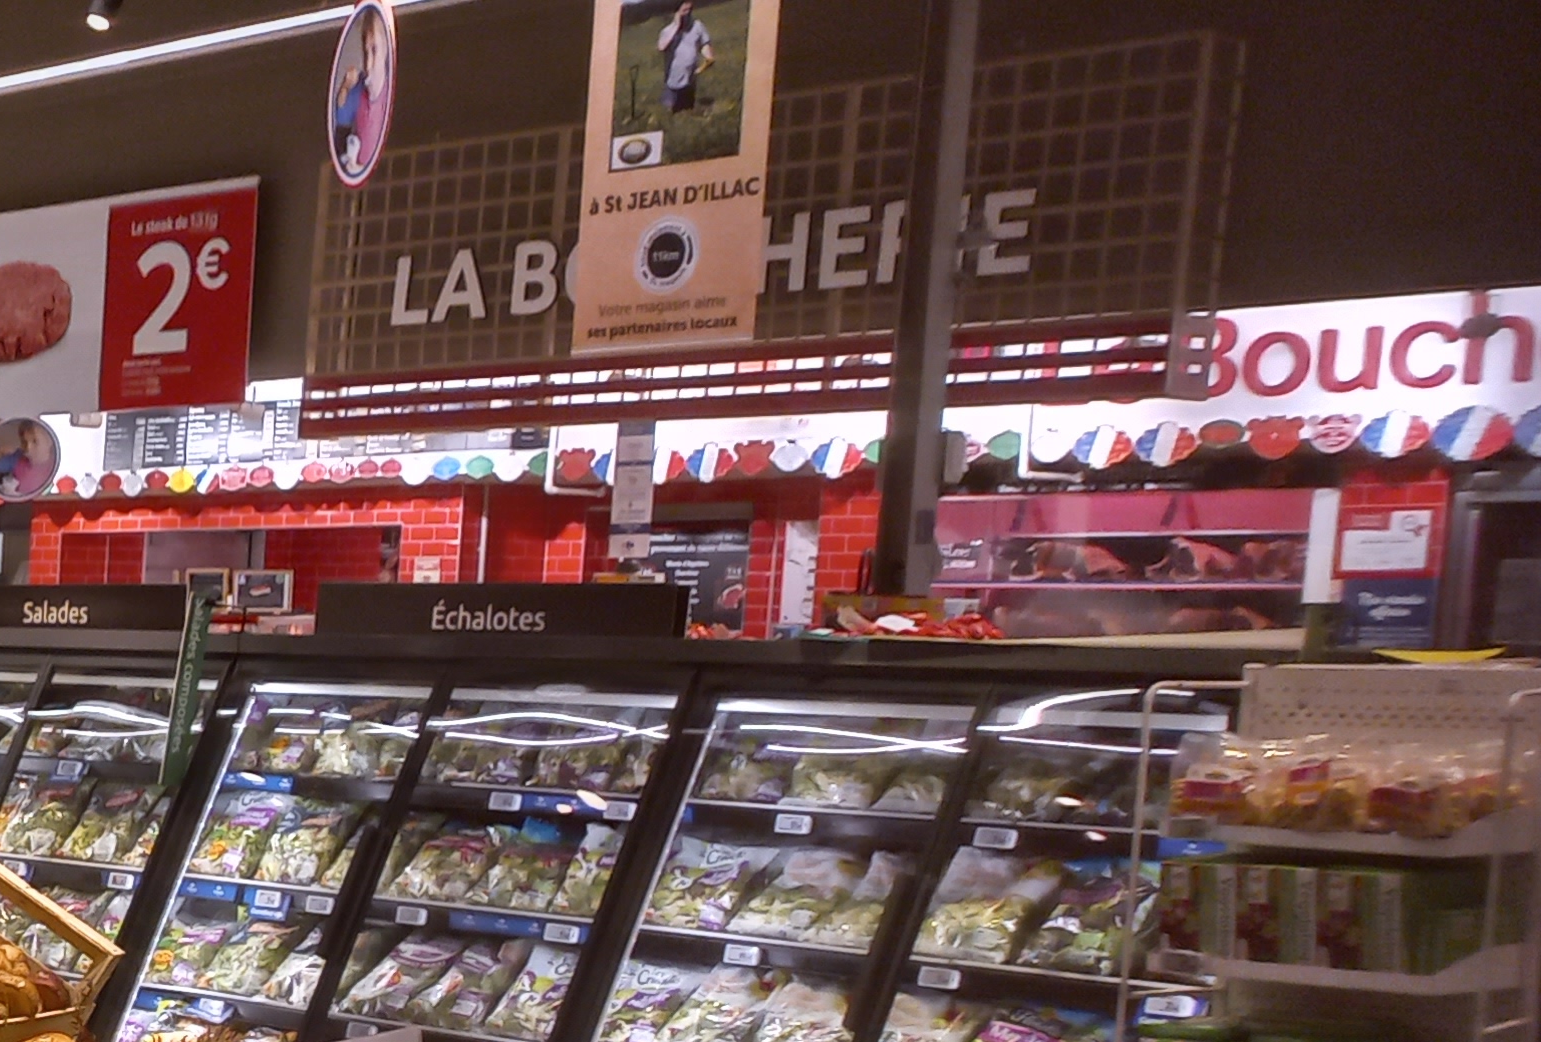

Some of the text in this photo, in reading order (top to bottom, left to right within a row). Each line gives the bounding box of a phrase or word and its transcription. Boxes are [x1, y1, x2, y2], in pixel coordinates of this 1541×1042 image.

[589, 176, 760, 216] à St JEAN D'ILLAC
[390, 248, 487, 327] LA
[598, 303, 632, 318] Votre
[609, 319, 687, 340] partenaires
[690, 316, 738, 330] locaux
[22, 600, 89, 625] Salades
[430, 604, 546, 633] Échalotes
